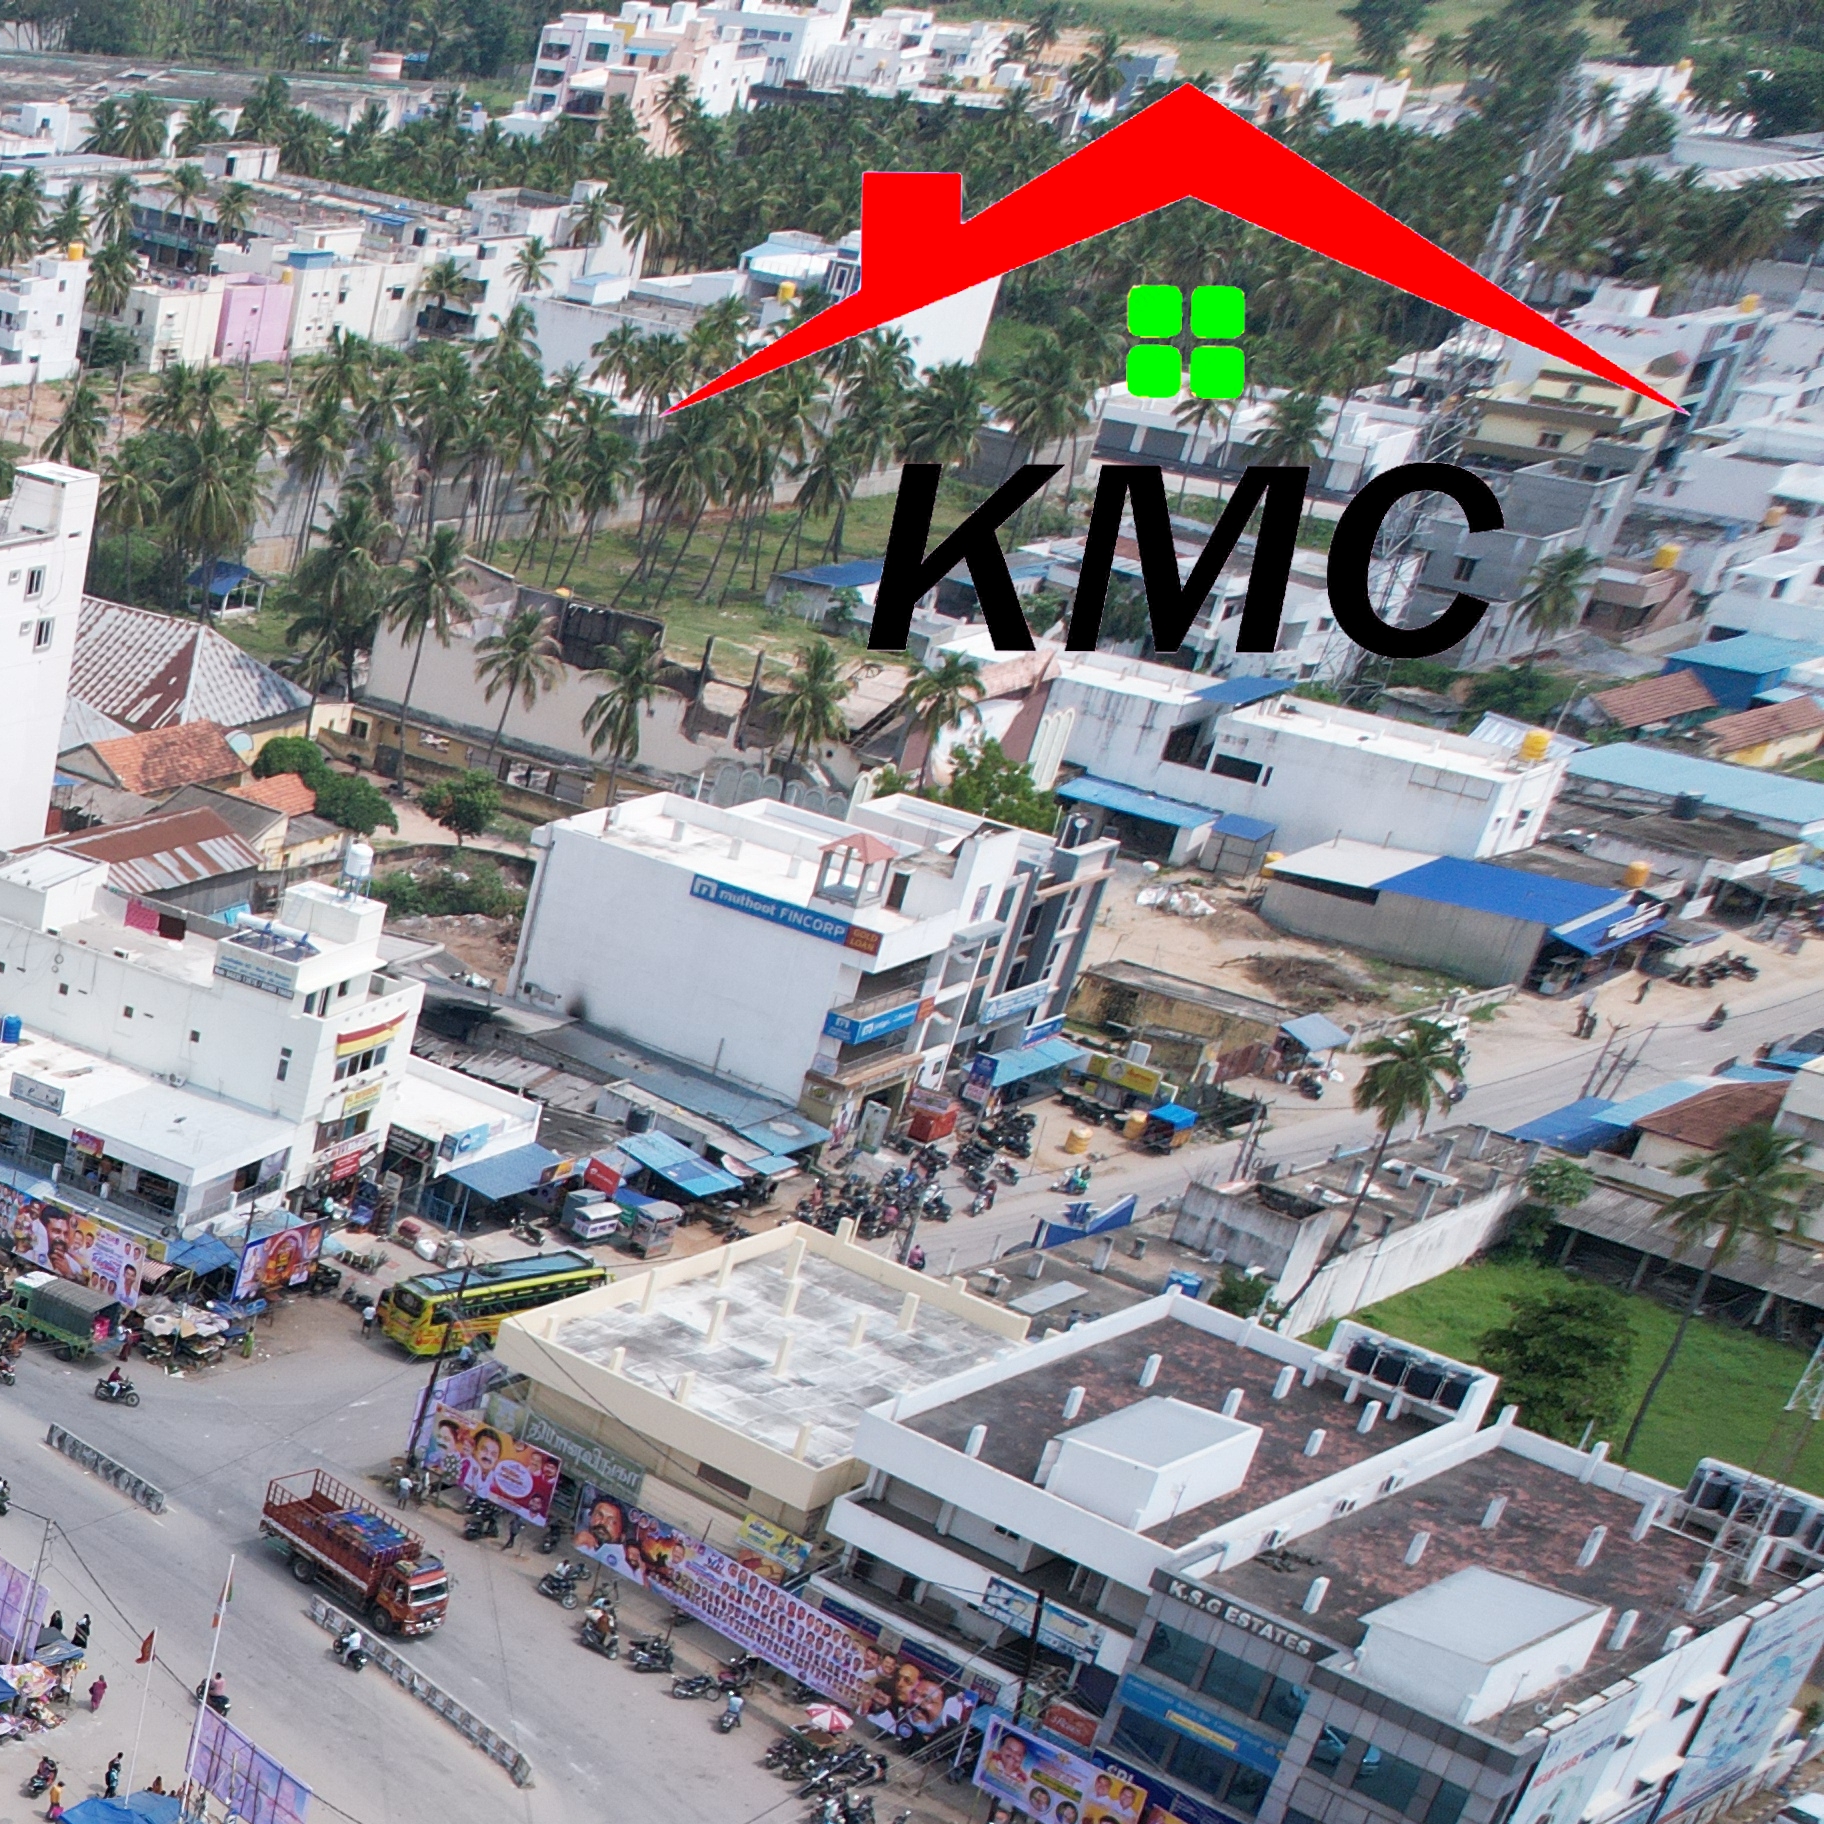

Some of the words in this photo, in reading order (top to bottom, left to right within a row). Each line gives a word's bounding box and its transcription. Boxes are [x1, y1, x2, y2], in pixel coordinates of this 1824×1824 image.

[718, 889, 777, 917] muthoot
[778, 906, 846, 938] FINCORP
[1168, 1579, 1222, 1614] K.S.G
[1224, 1605, 1313, 1655] ESTATES
